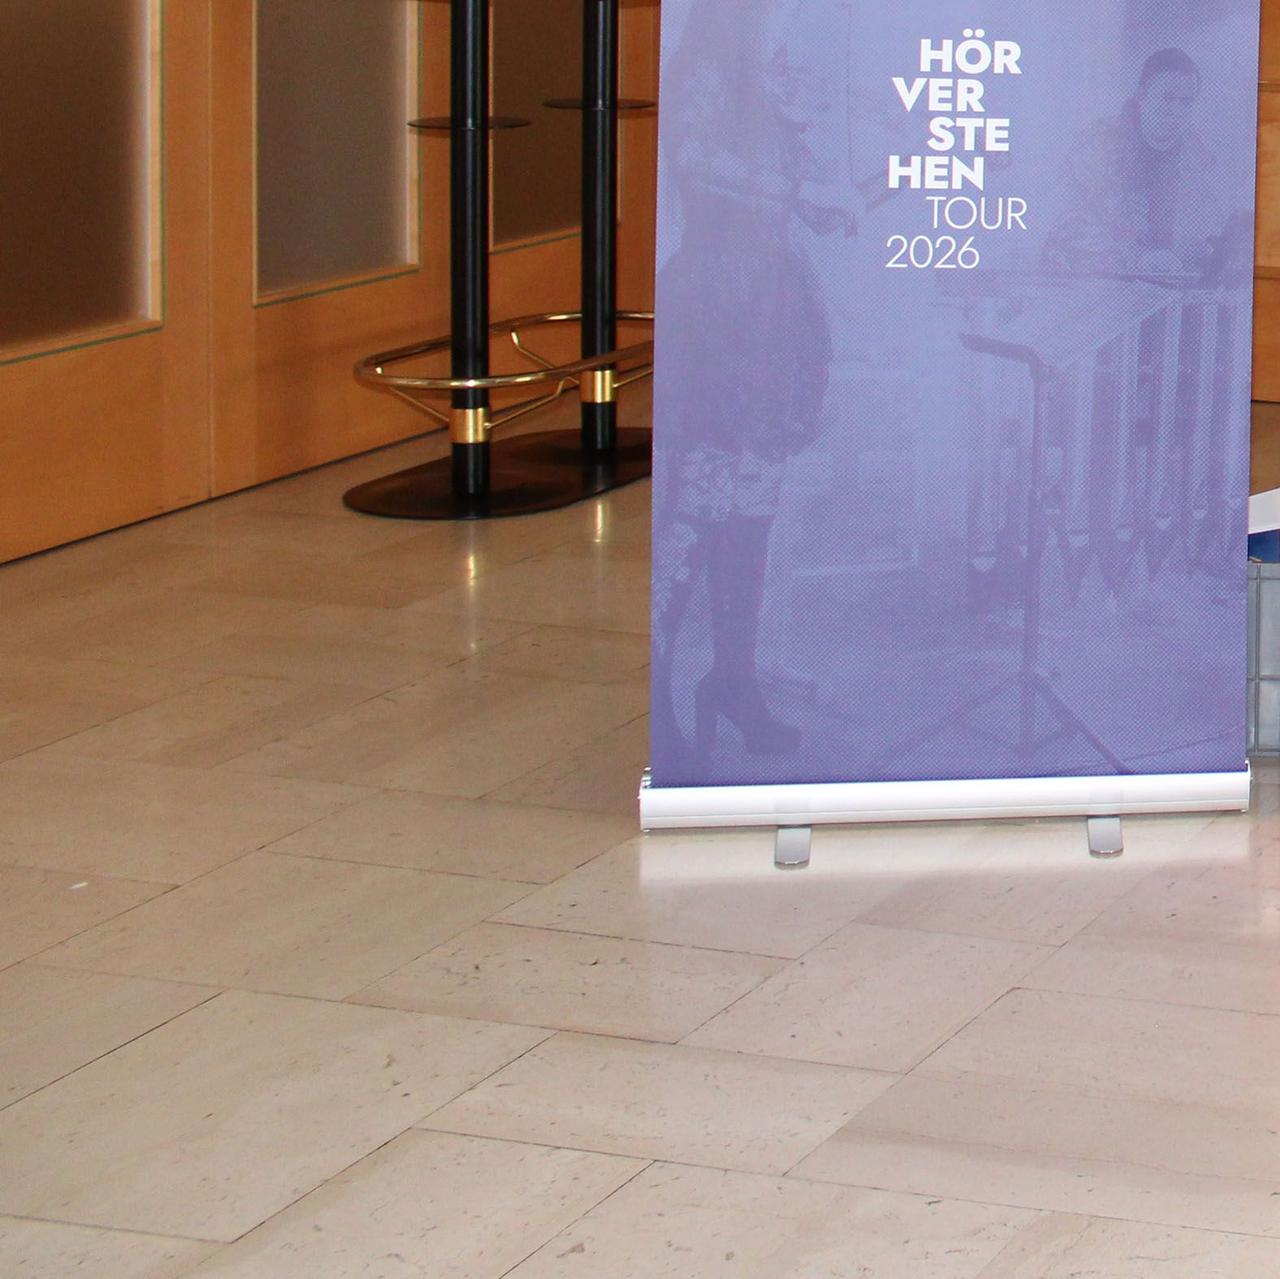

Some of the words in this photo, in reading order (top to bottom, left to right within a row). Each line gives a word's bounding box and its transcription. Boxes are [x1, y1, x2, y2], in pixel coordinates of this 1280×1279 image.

[919, 28, 1023, 75] HÖR
[891, 76, 986, 113] VER
[927, 116, 1011, 152] STE
[888, 154, 985, 192] HEN
[926, 195, 1028, 230] TOUR
[885, 234, 980, 269] 2026
